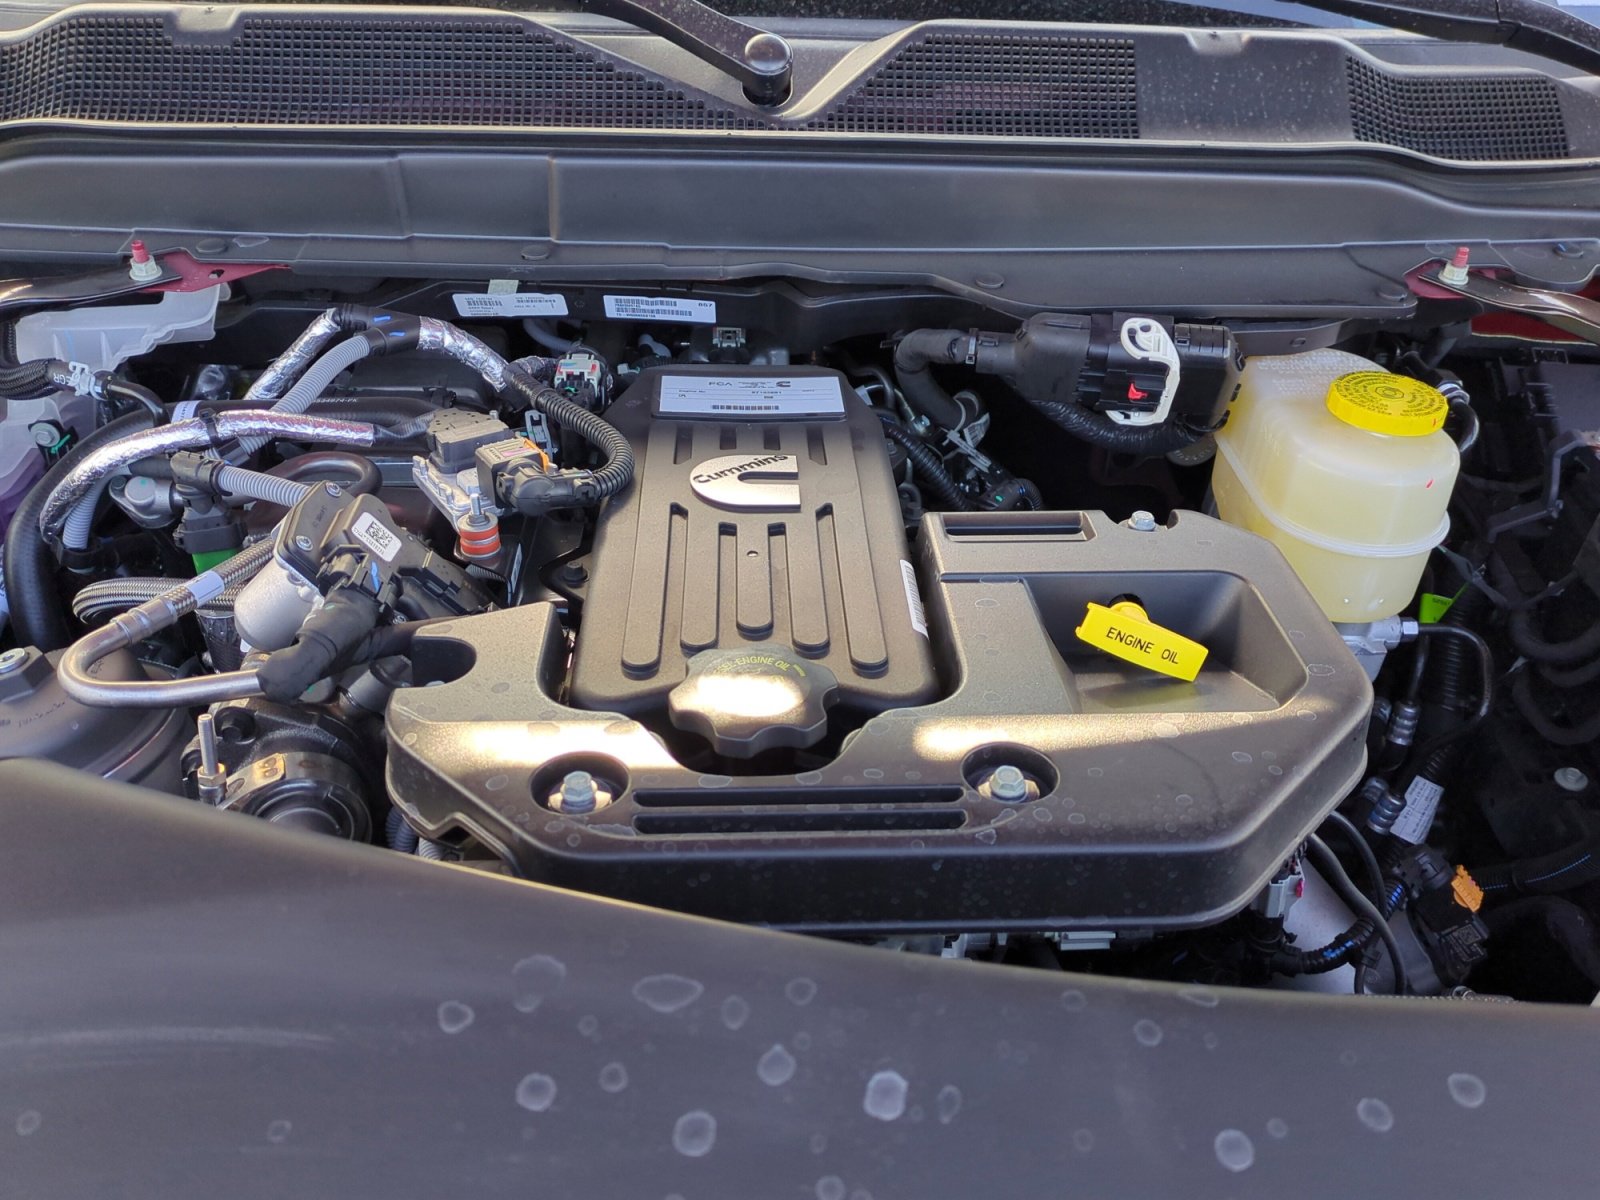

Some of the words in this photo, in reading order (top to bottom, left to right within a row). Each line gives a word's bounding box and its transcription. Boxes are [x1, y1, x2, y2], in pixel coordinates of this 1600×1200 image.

[693, 455, 788, 483] Cummins
[1106, 627, 1155, 654] ENGINE
[1161, 648, 1179, 665] OIL
[775, 660, 790, 672] OIL
